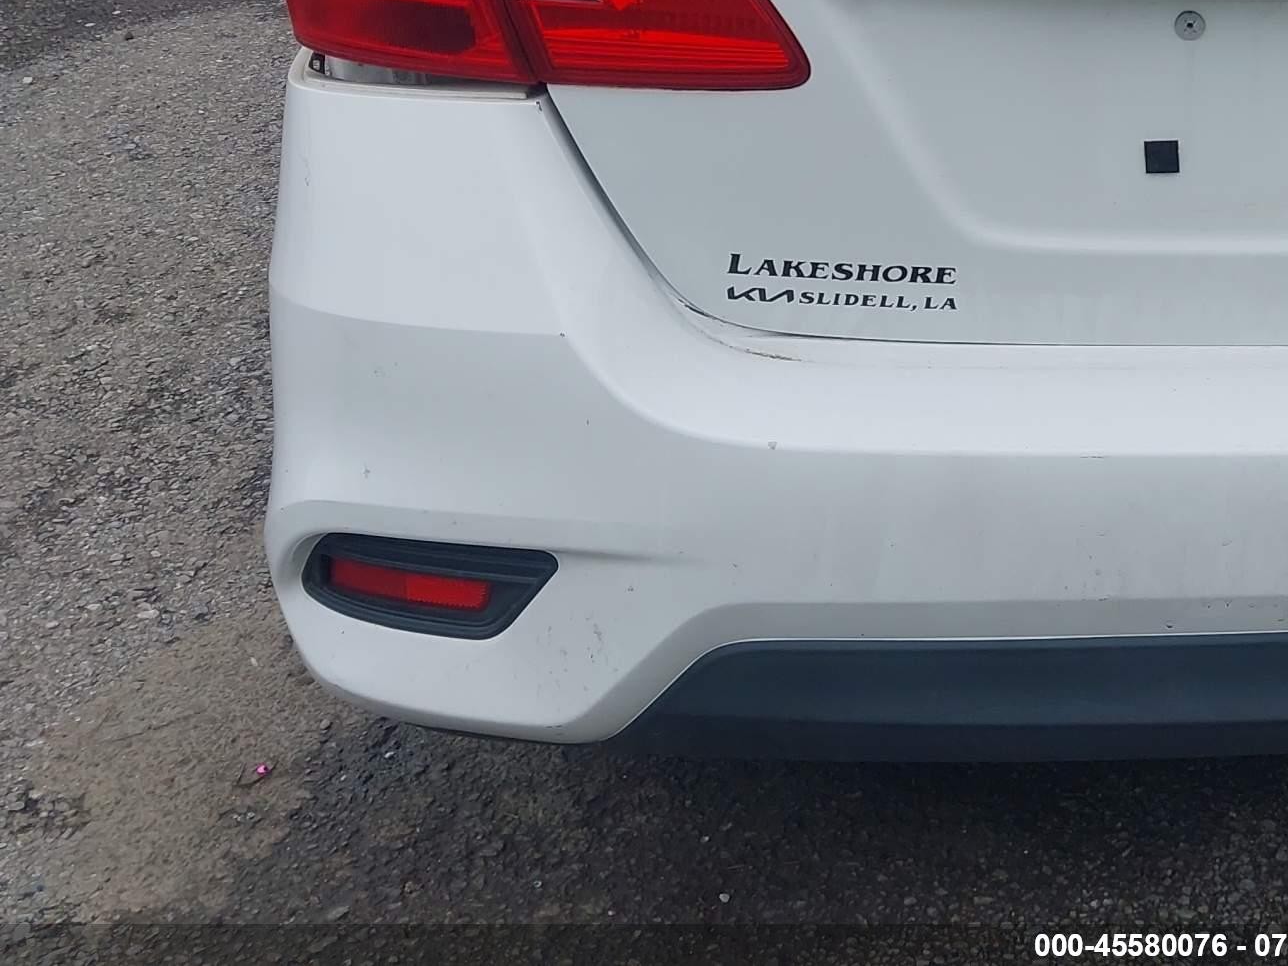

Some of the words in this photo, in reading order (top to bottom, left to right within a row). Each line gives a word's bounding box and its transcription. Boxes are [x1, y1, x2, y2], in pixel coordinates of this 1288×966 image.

[727, 253, 957, 284] LAKESHORE
[799, 291, 918, 312] SLIDELL,
[924, 296, 957, 310] LA
